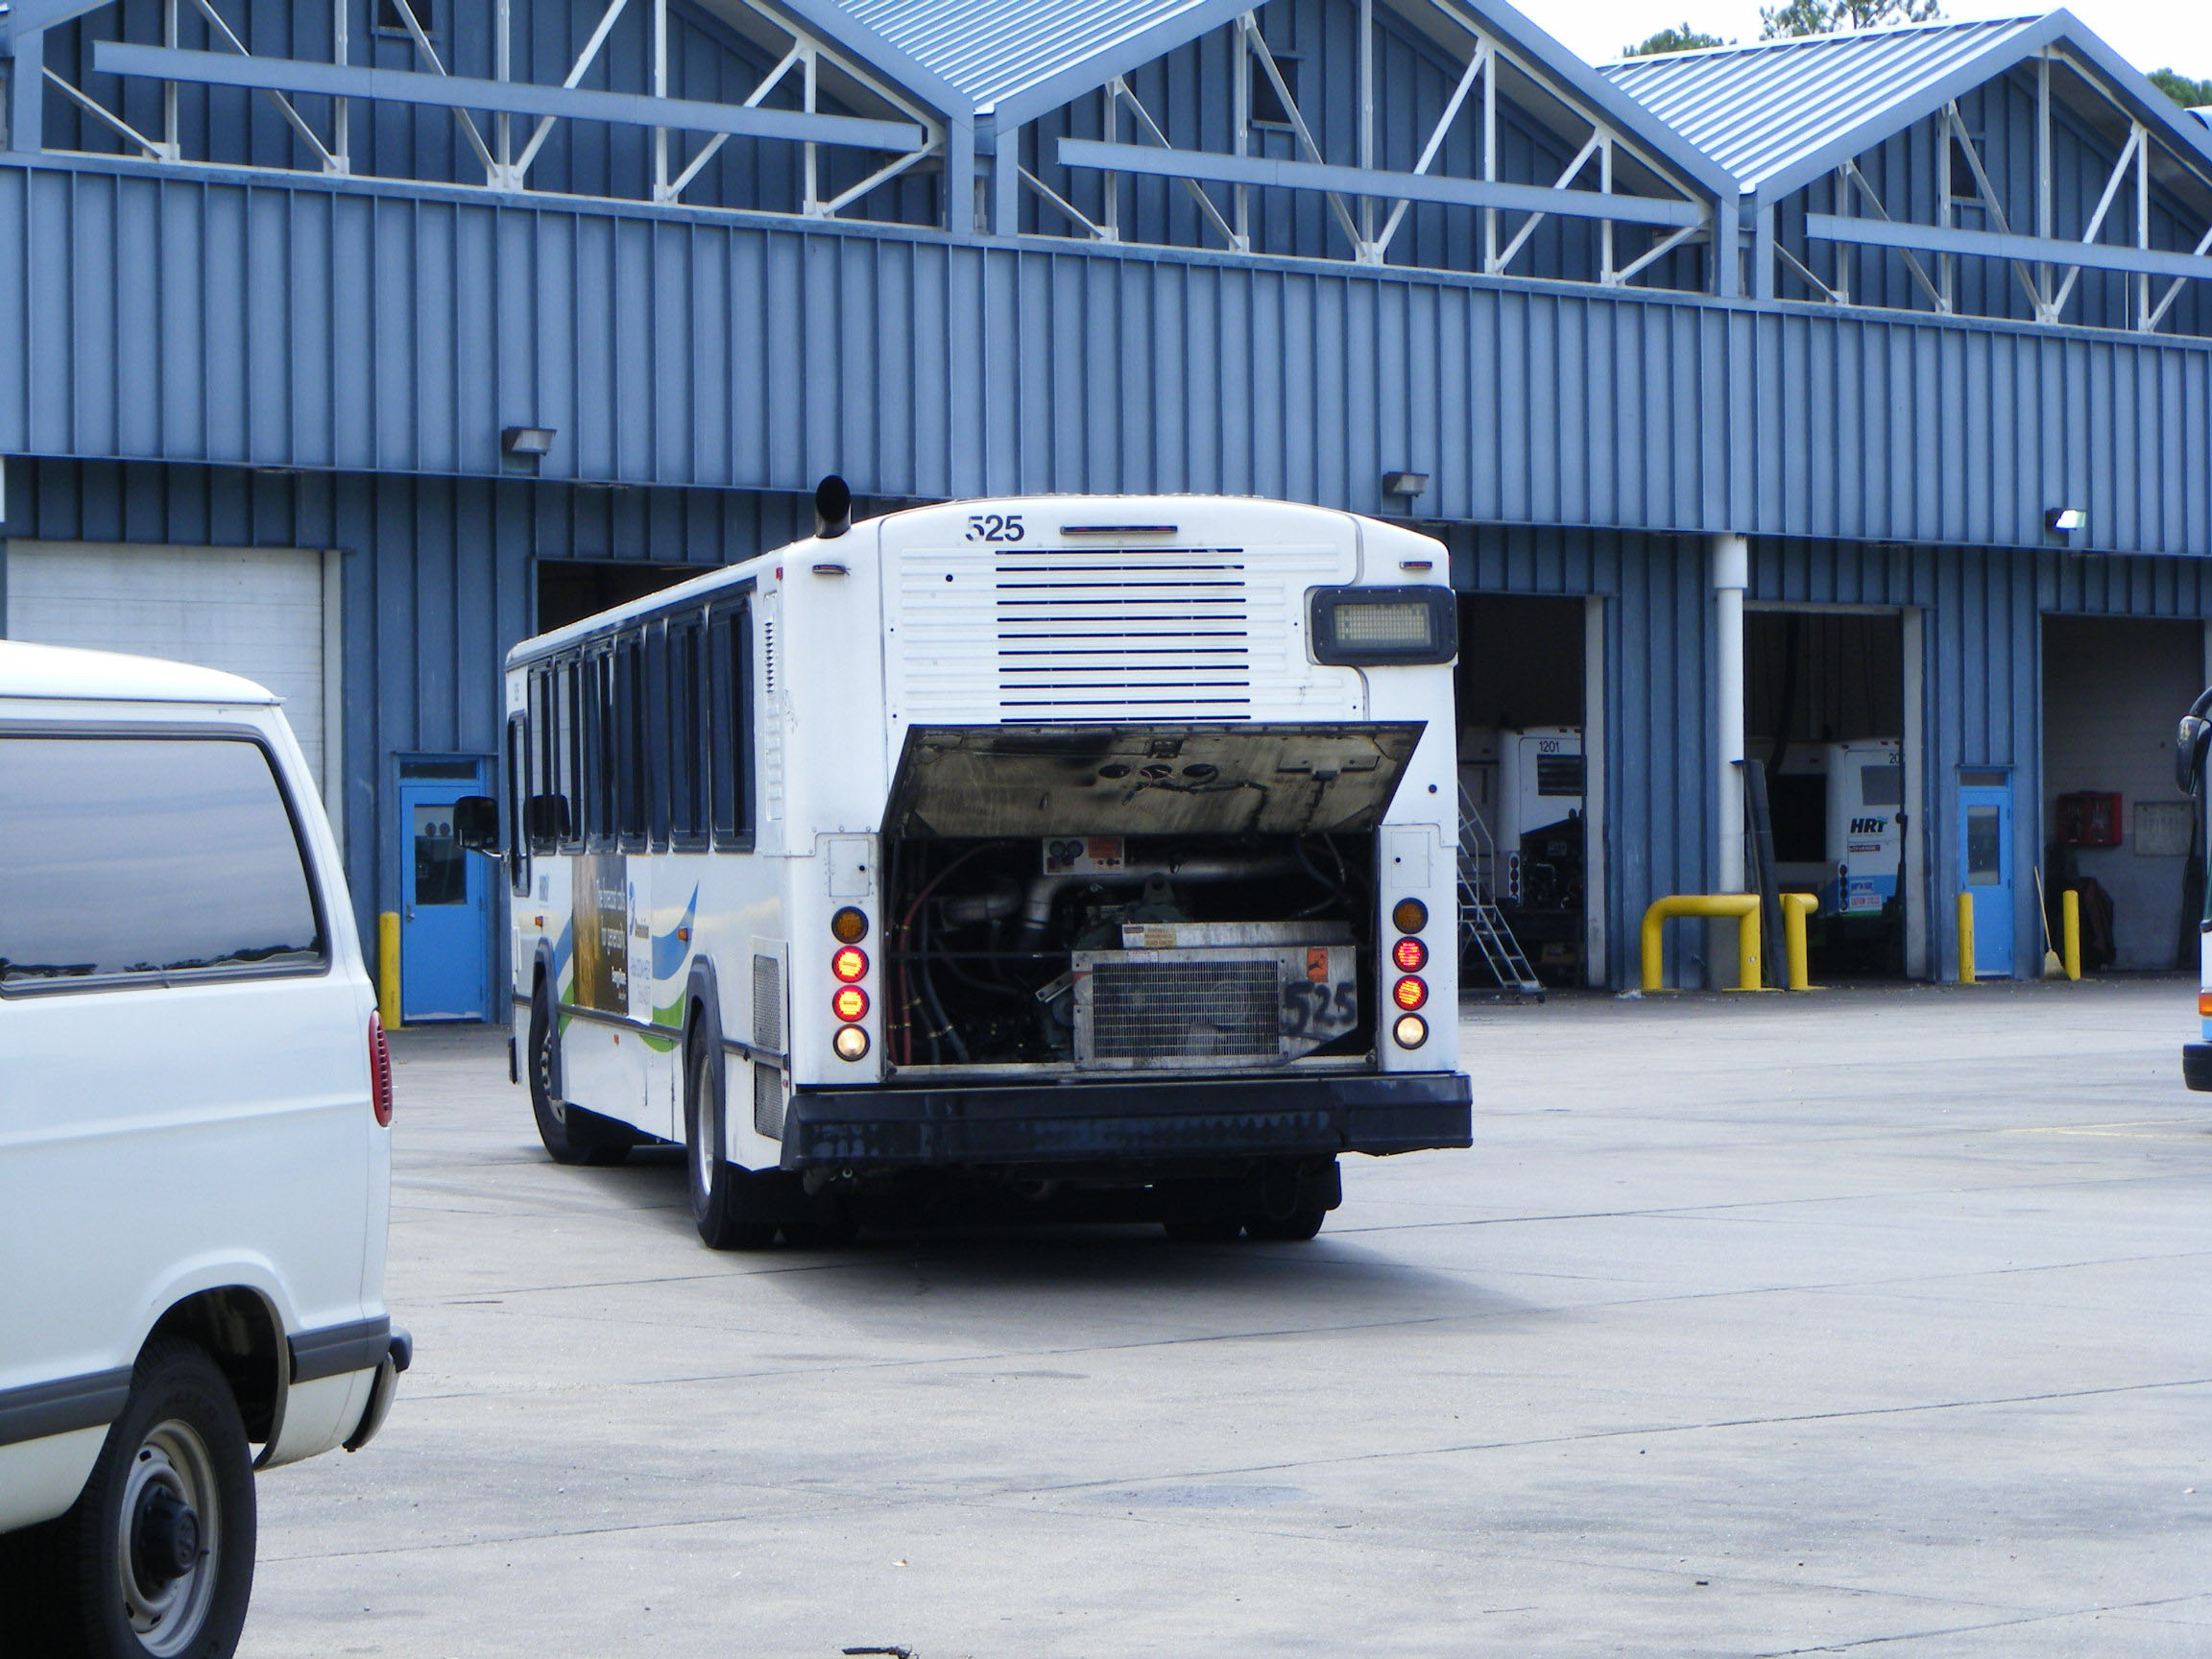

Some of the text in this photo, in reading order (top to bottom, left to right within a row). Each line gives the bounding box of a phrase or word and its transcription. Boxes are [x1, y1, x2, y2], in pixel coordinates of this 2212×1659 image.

[965, 515, 1024, 541] 525
[1539, 740, 1559, 753] 1201
[1850, 818, 1887, 833] HRT
[1280, 981, 1356, 1037] 525
